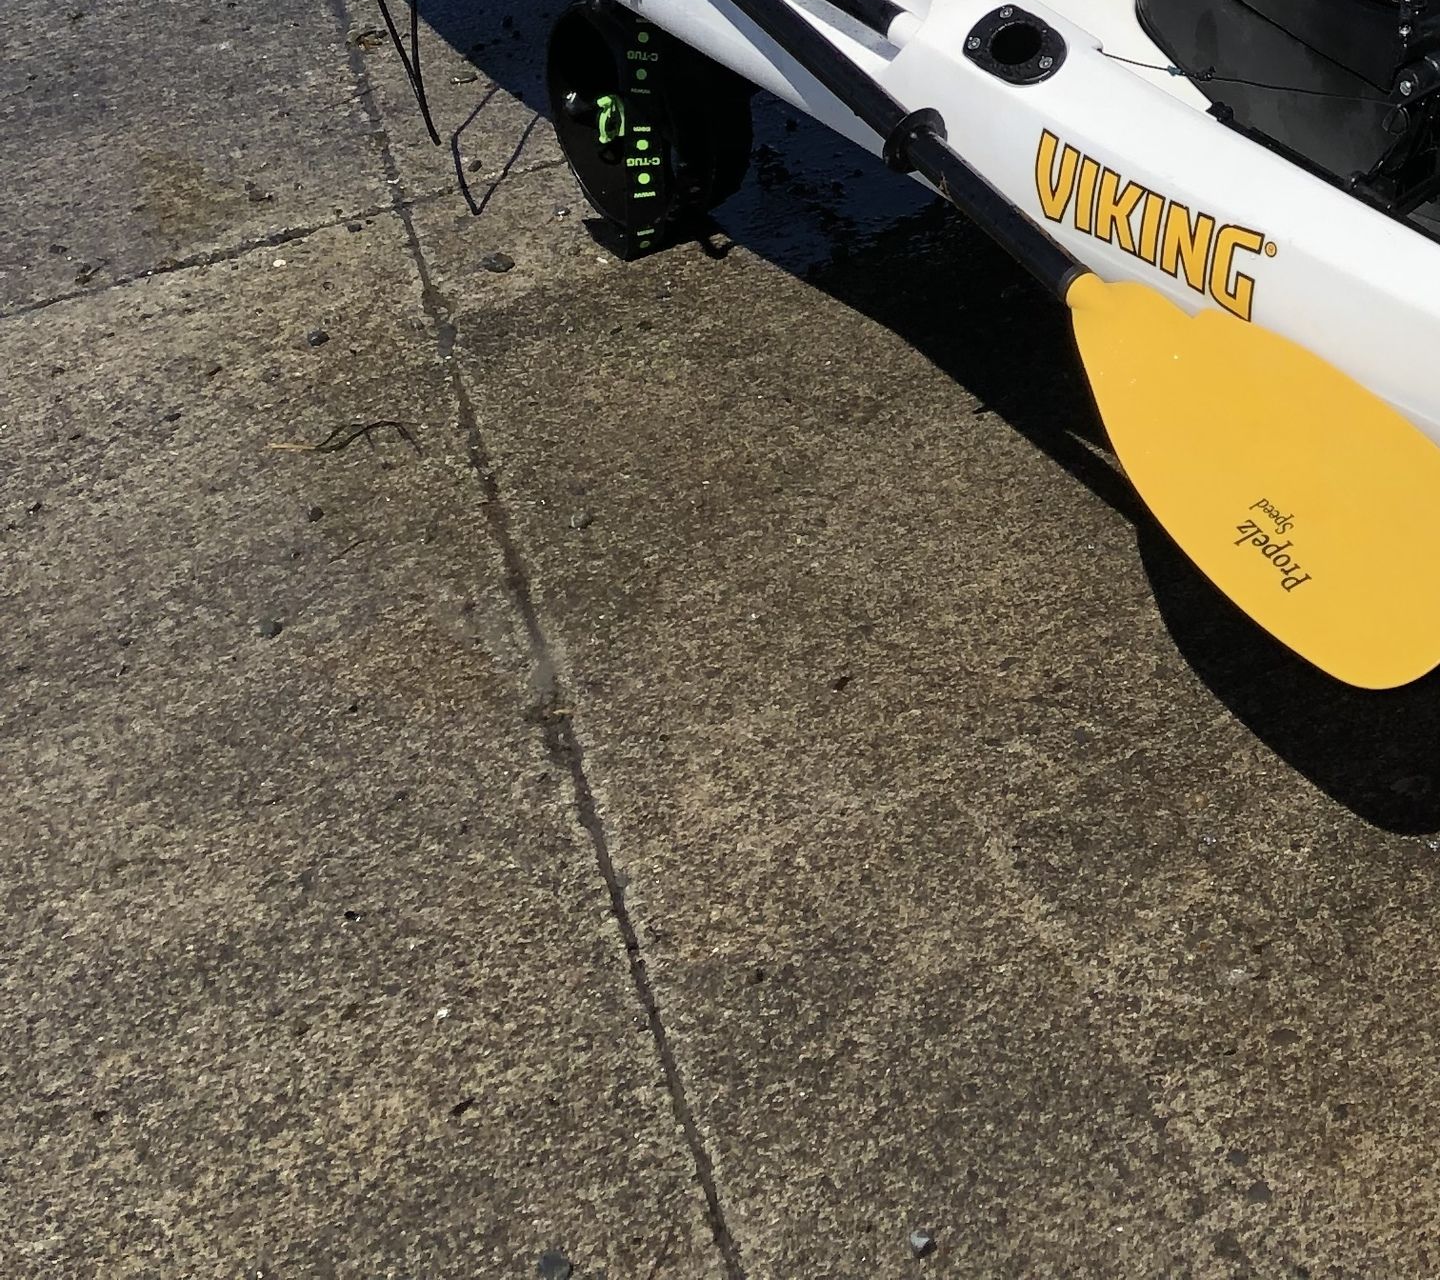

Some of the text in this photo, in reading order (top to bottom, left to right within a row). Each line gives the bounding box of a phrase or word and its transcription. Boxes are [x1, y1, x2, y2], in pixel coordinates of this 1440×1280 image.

[627, 50, 659, 62] C-TUG
[626, 157, 661, 167] C-TUG
[1035, 127, 1266, 323] VIKING
[1249, 497, 1295, 535] Speed
[1233, 519, 1313, 593] Propelz
